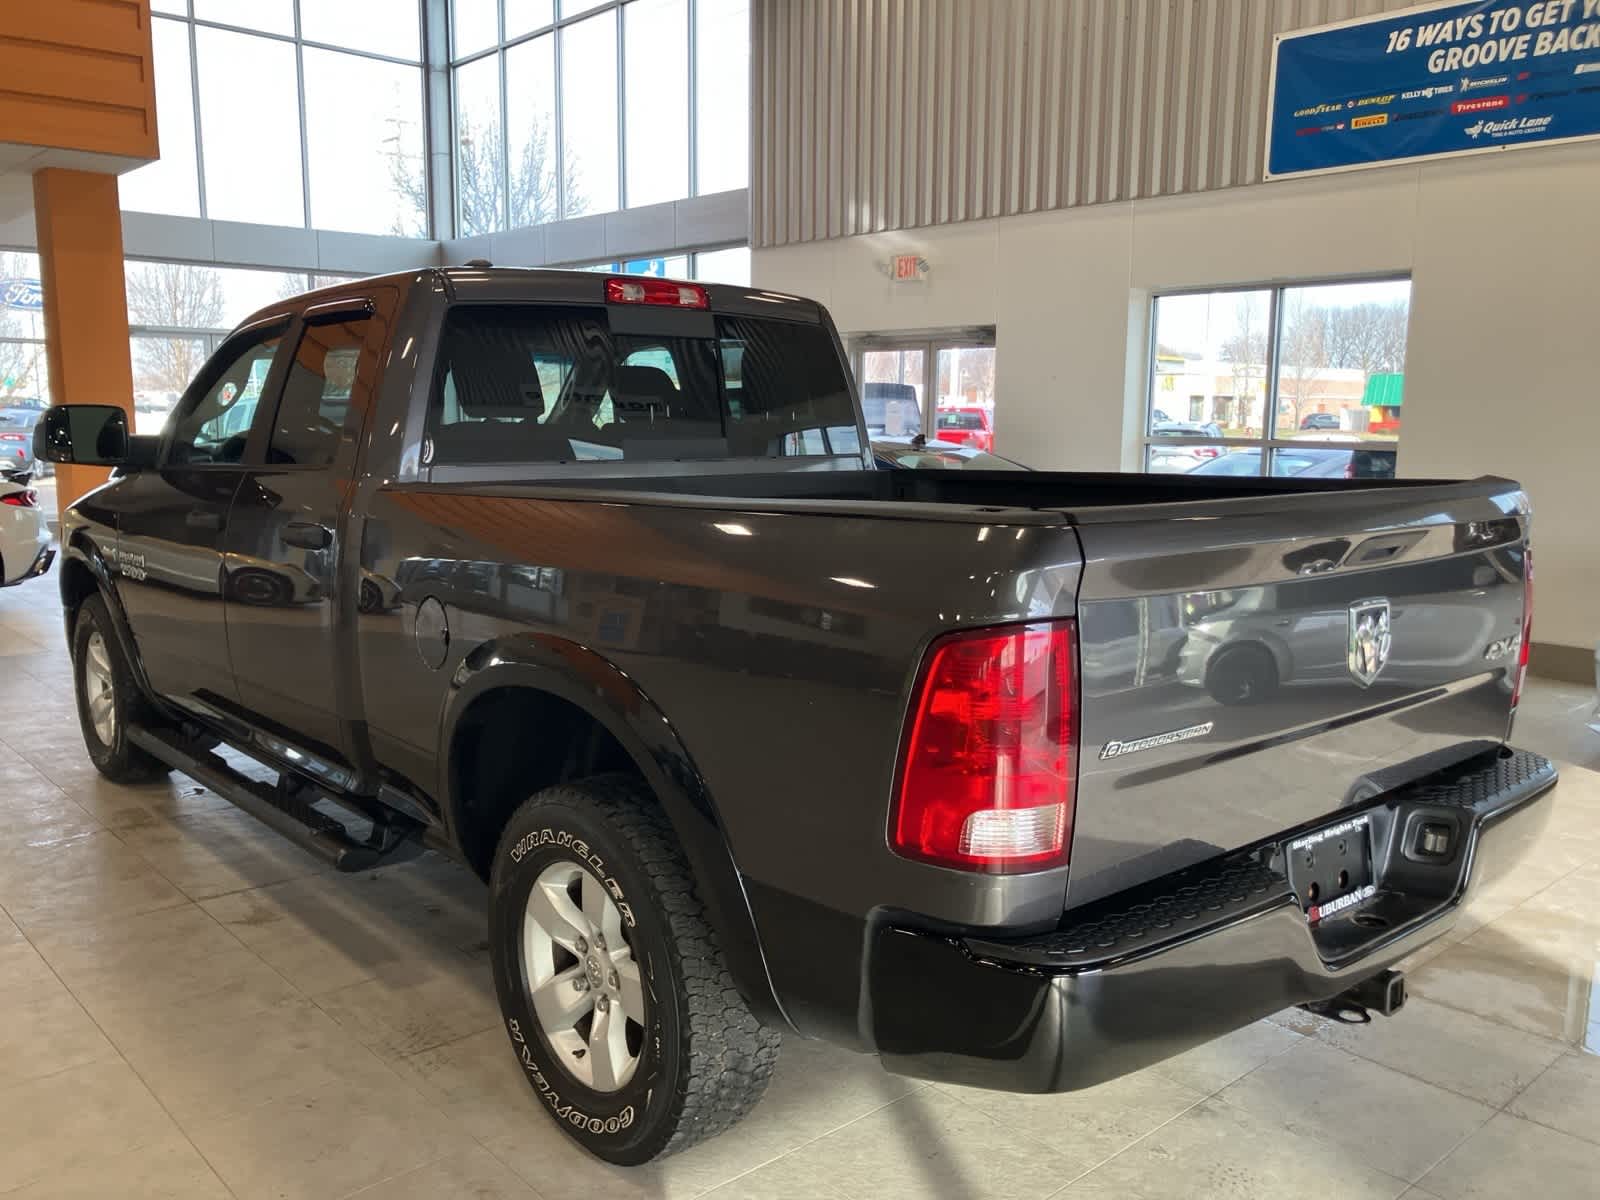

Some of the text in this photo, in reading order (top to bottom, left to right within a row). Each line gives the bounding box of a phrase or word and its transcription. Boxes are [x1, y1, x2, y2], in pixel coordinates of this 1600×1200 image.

[1386, 28, 1413, 53] 16
[1416, 13, 1485, 47] WAYS
[1489, 7, 1521, 35] TO
[1525, 0, 1575, 28] GET
[1427, 23, 1600, 73] GROOVE BACK
[1358, 94, 1397, 105] DUNLOP
[1401, 85, 1453, 99] KELLY TIRES
[1294, 103, 1342, 117] GOODYEAR
[1483, 116, 1553, 134] Quick Lane
[897, 256, 917, 279] EXIT
[511, 828, 635, 928] WRANGLER
[510, 1018, 634, 1134] GOODYEAR
